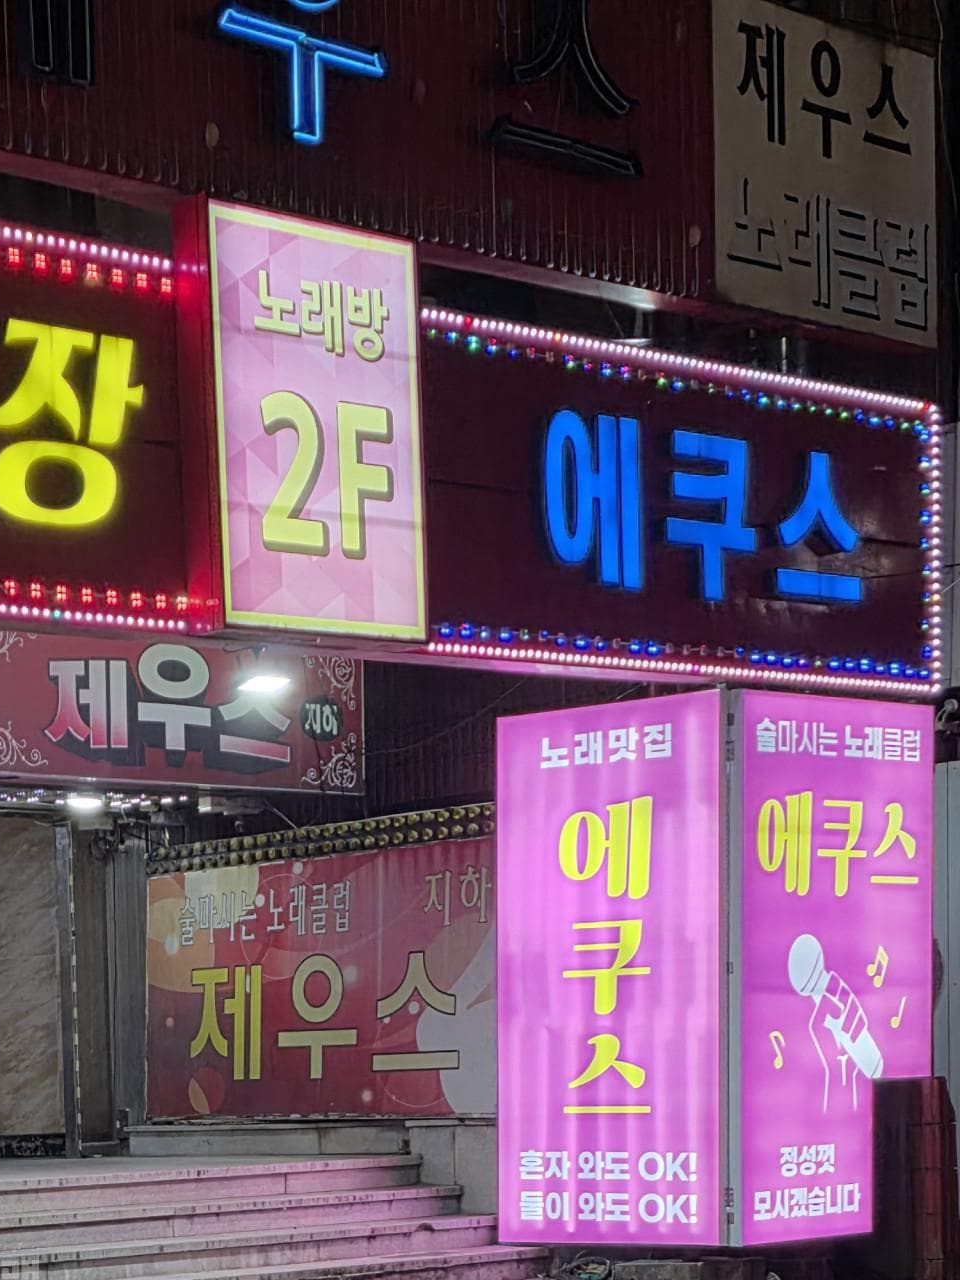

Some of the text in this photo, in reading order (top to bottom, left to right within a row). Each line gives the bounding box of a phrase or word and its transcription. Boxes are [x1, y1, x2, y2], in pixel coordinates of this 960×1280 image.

[735, 18, 913, 159] 제우스
[726, 177, 930, 332] 노래클럽
[254, 269, 390, 362] 노래방
[260, 390, 394, 560] 2F
[545, 409, 864, 602] 에쿠스
[43, 643, 292, 764] 제우스
[305, 703, 338, 735] 지하
[756, 717, 921, 762] 술마시는 노래클럽
[540, 722, 673, 769] 노래맛집
[757, 790, 919, 897] 에쿠스
[266, 880, 351, 936] 노래클럽
[423, 865, 492, 927] 지하
[558, 795, 654, 1114] 에쿠스
[190, 950, 460, 1081] 제우스
[519, 1149, 698, 1182] 혼자 와도 OK!
[779, 1143, 836, 1178] 정성껏
[519, 1190, 698, 1224] 둘이 와도 OK!
[753, 1183, 861, 1221] 모시겠습니다
